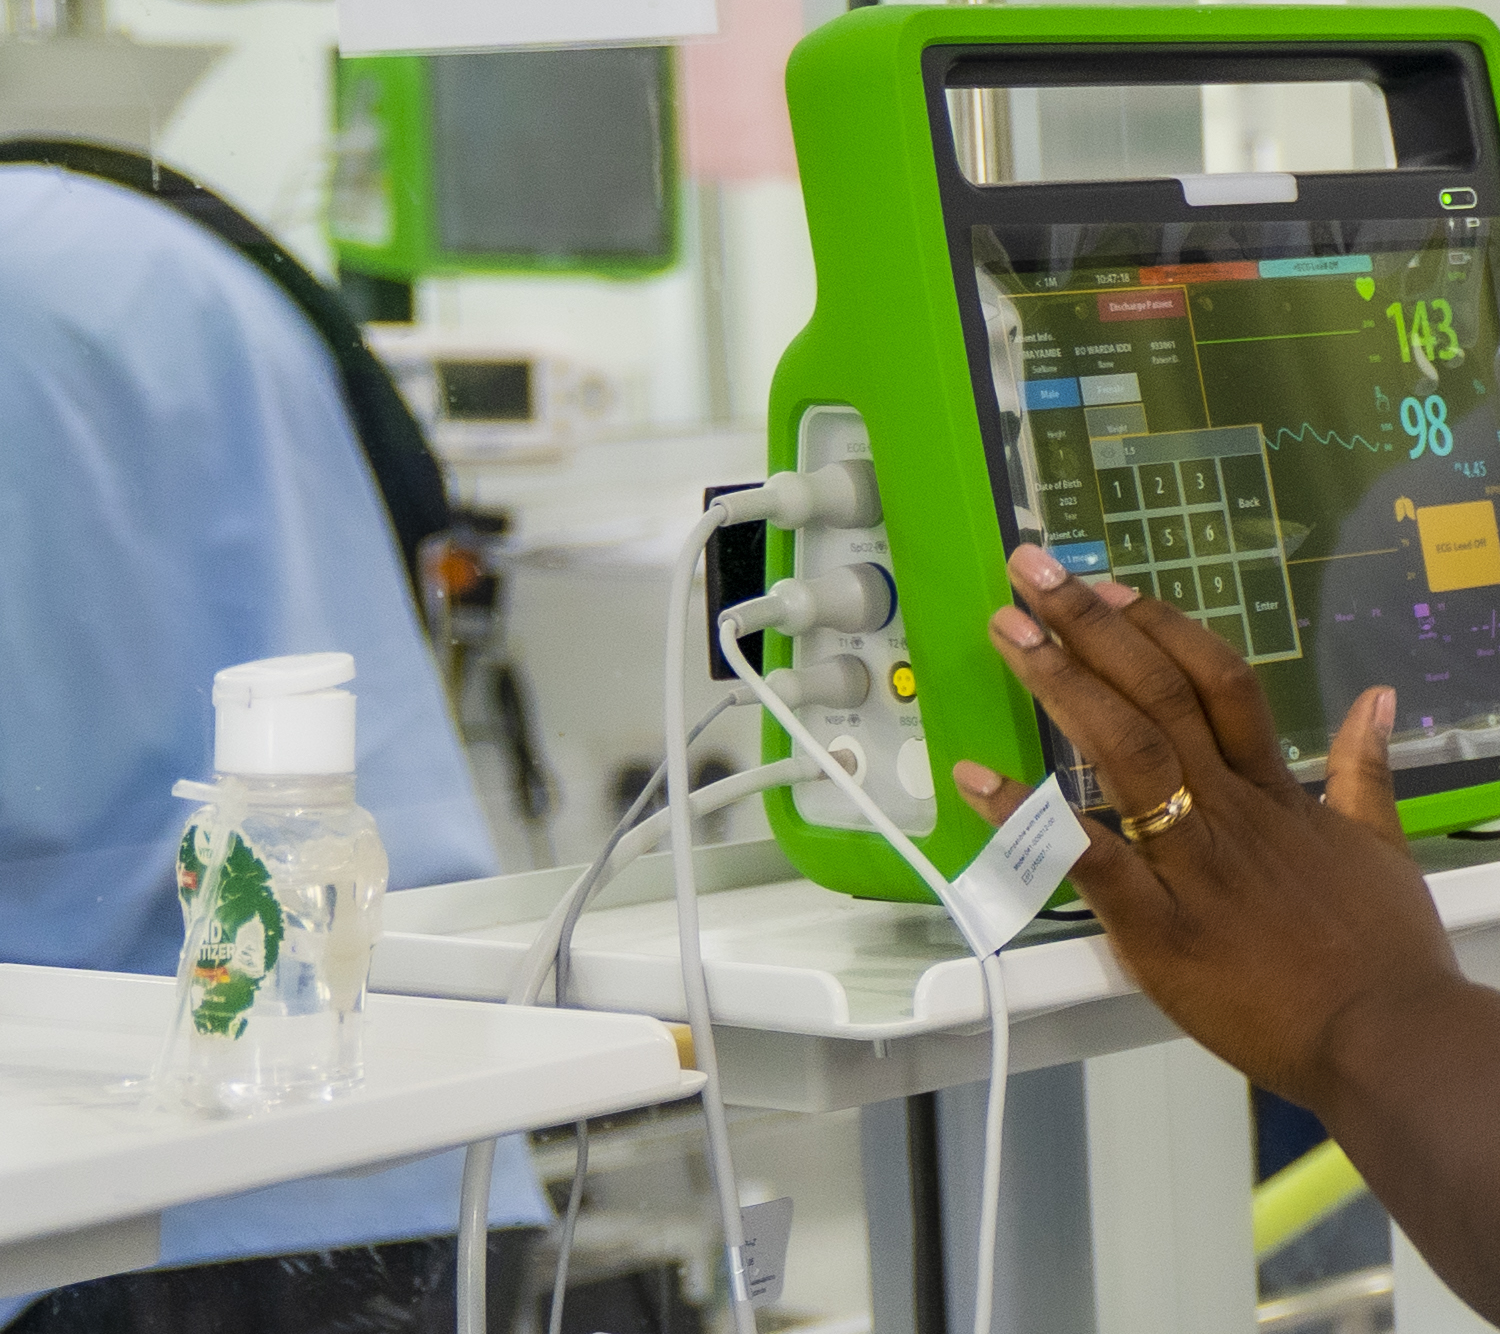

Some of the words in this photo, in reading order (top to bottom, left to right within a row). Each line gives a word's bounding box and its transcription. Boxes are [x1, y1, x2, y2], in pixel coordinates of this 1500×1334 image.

[1385, 298, 1461, 364] 143
[1040, 389, 1060, 400] Male
[1400, 394, 1454, 460] 98
[846, 443, 866, 453] ECG
[1054, 480, 1062, 489] of
[1062, 478, 1083, 489] Birth
[1113, 481, 1122, 498] 1
[1155, 477, 1164, 494] 2
[1196, 472, 1205, 489] 3
[1238, 496, 1261, 509] Back
[1047, 531, 1072, 541] atient
[1124, 533, 1132, 551] 4
[1165, 529, 1174, 546] 5
[1206, 525, 1215, 541] 6
[850, 542, 874, 553] SpO2
[1174, 581, 1183, 598] 8
[1214, 576, 1223, 594] 9
[1255, 600, 1279, 612] Enter
[839, 637, 848, 647] T1
[888, 638, 899, 648] T2
